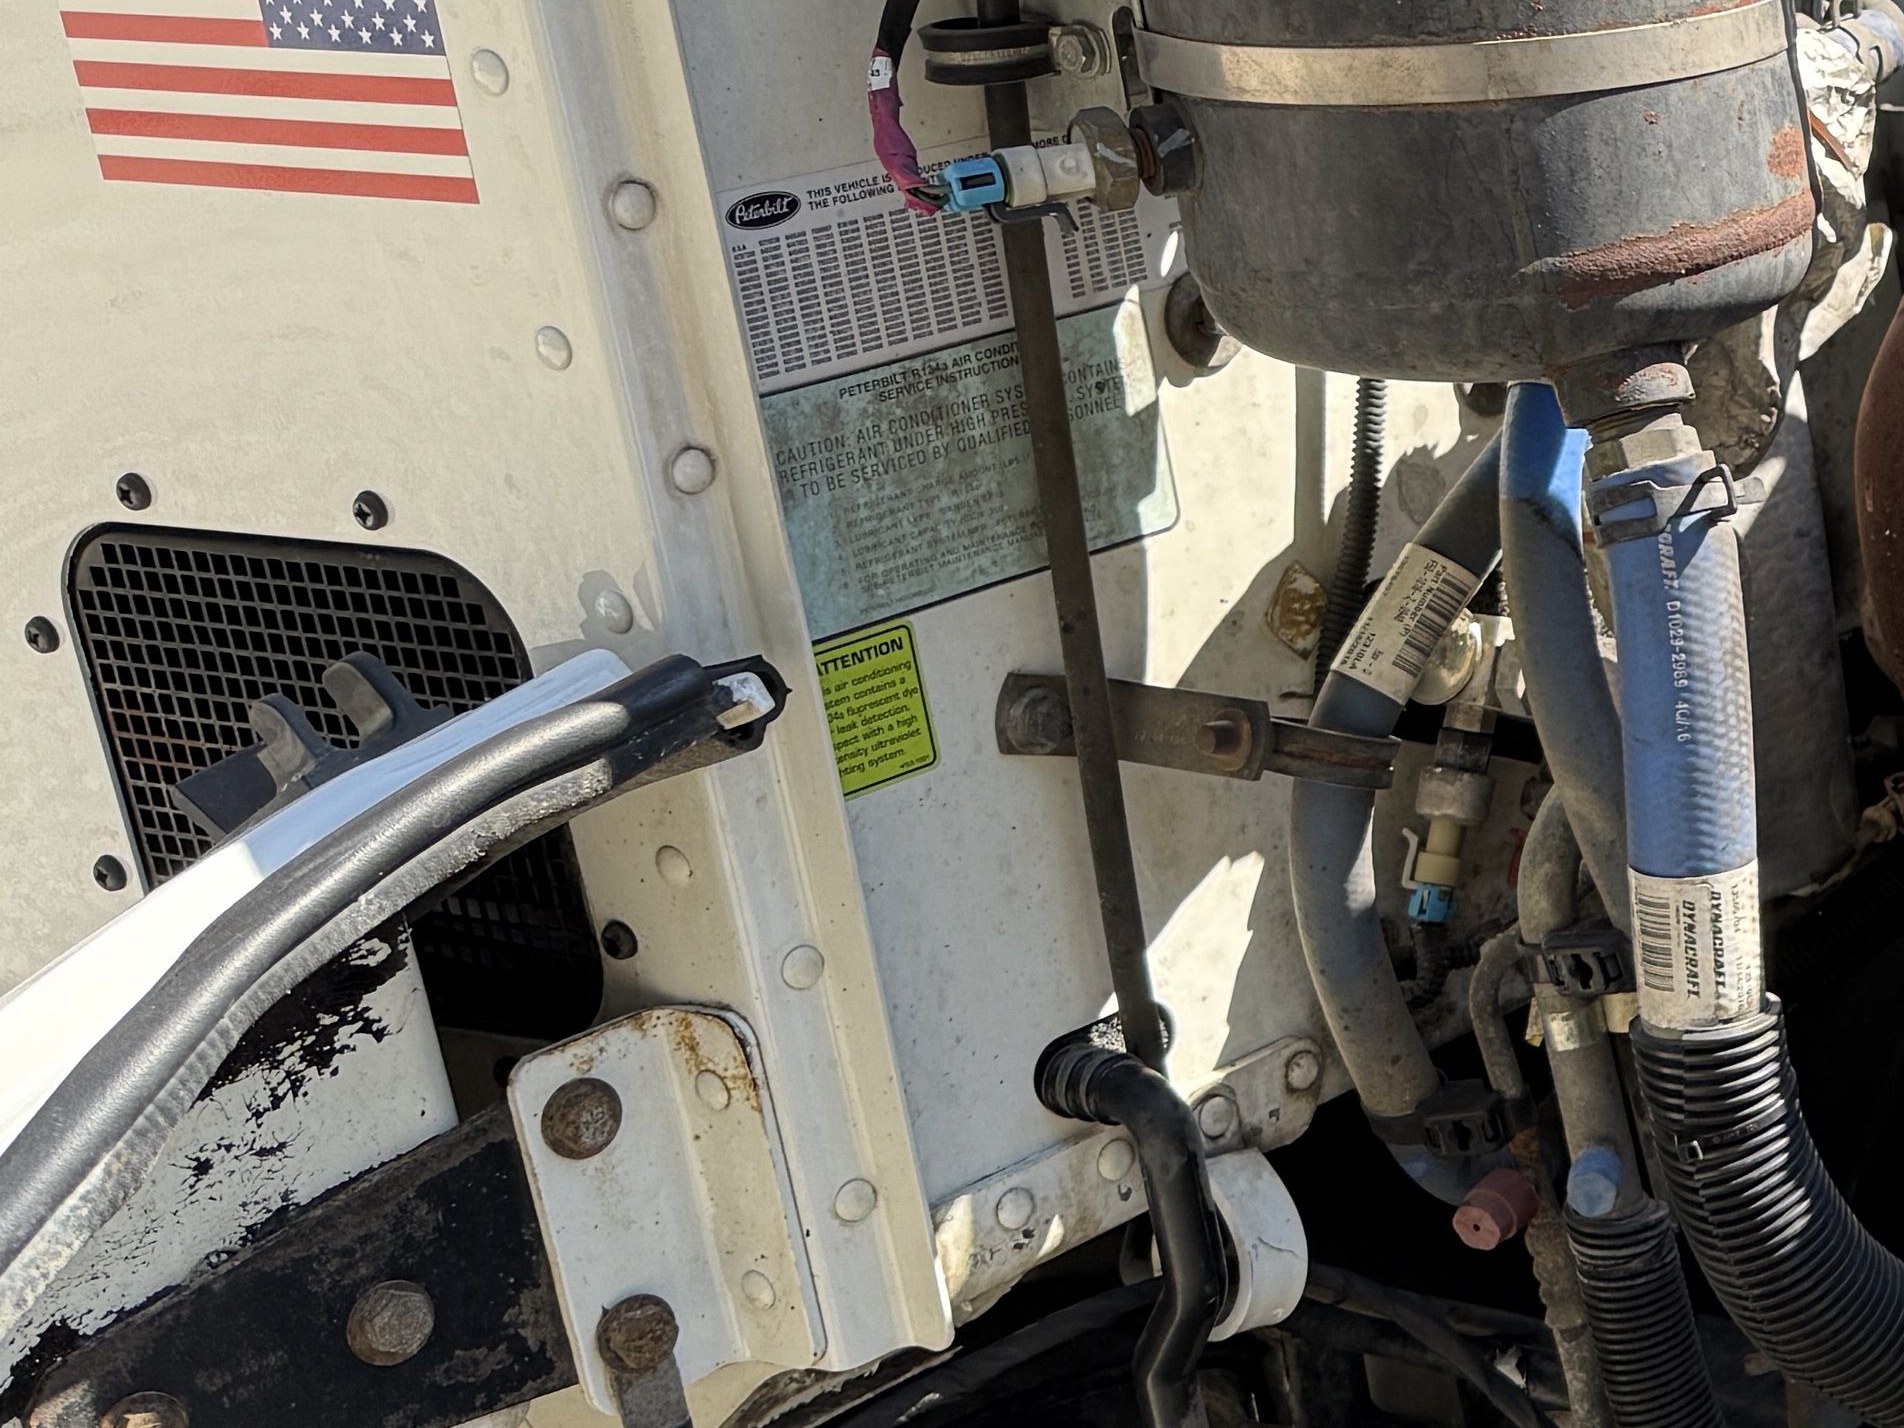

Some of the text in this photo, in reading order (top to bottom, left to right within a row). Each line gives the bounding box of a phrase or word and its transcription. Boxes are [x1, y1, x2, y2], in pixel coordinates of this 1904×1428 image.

[807, 188, 833, 200] THIS
[836, 178, 879, 194] VEHICLE
[809, 184, 894, 210] THE FOLLOWING
[735, 197, 790, 224] Peterbilt
[839, 372, 908, 399] PETERBILT
[951, 354, 972, 369] AIR
[879, 381, 933, 403] SERVICE
[776, 436, 851, 466] CAUTION:
[856, 424, 881, 444] AIR
[889, 394, 989, 434] CONDITIONER
[780, 442, 888, 484] REFRIGERANT
[893, 422, 944, 452] UNDER
[951, 412, 985, 435] HIGH
[800, 480, 820, 497] TO
[826, 471, 846, 492] BE
[851, 450, 927, 484] SERVICED
[933, 443, 950, 459] BY
[852, 660, 911, 686] conditioning
[854, 681, 896, 701] contains
[862, 728, 885, 741] with
[897, 714, 918, 729] high
[871, 728, 921, 751] ultraviolet
[1682, 899, 1701, 999] DYNACRAFT
